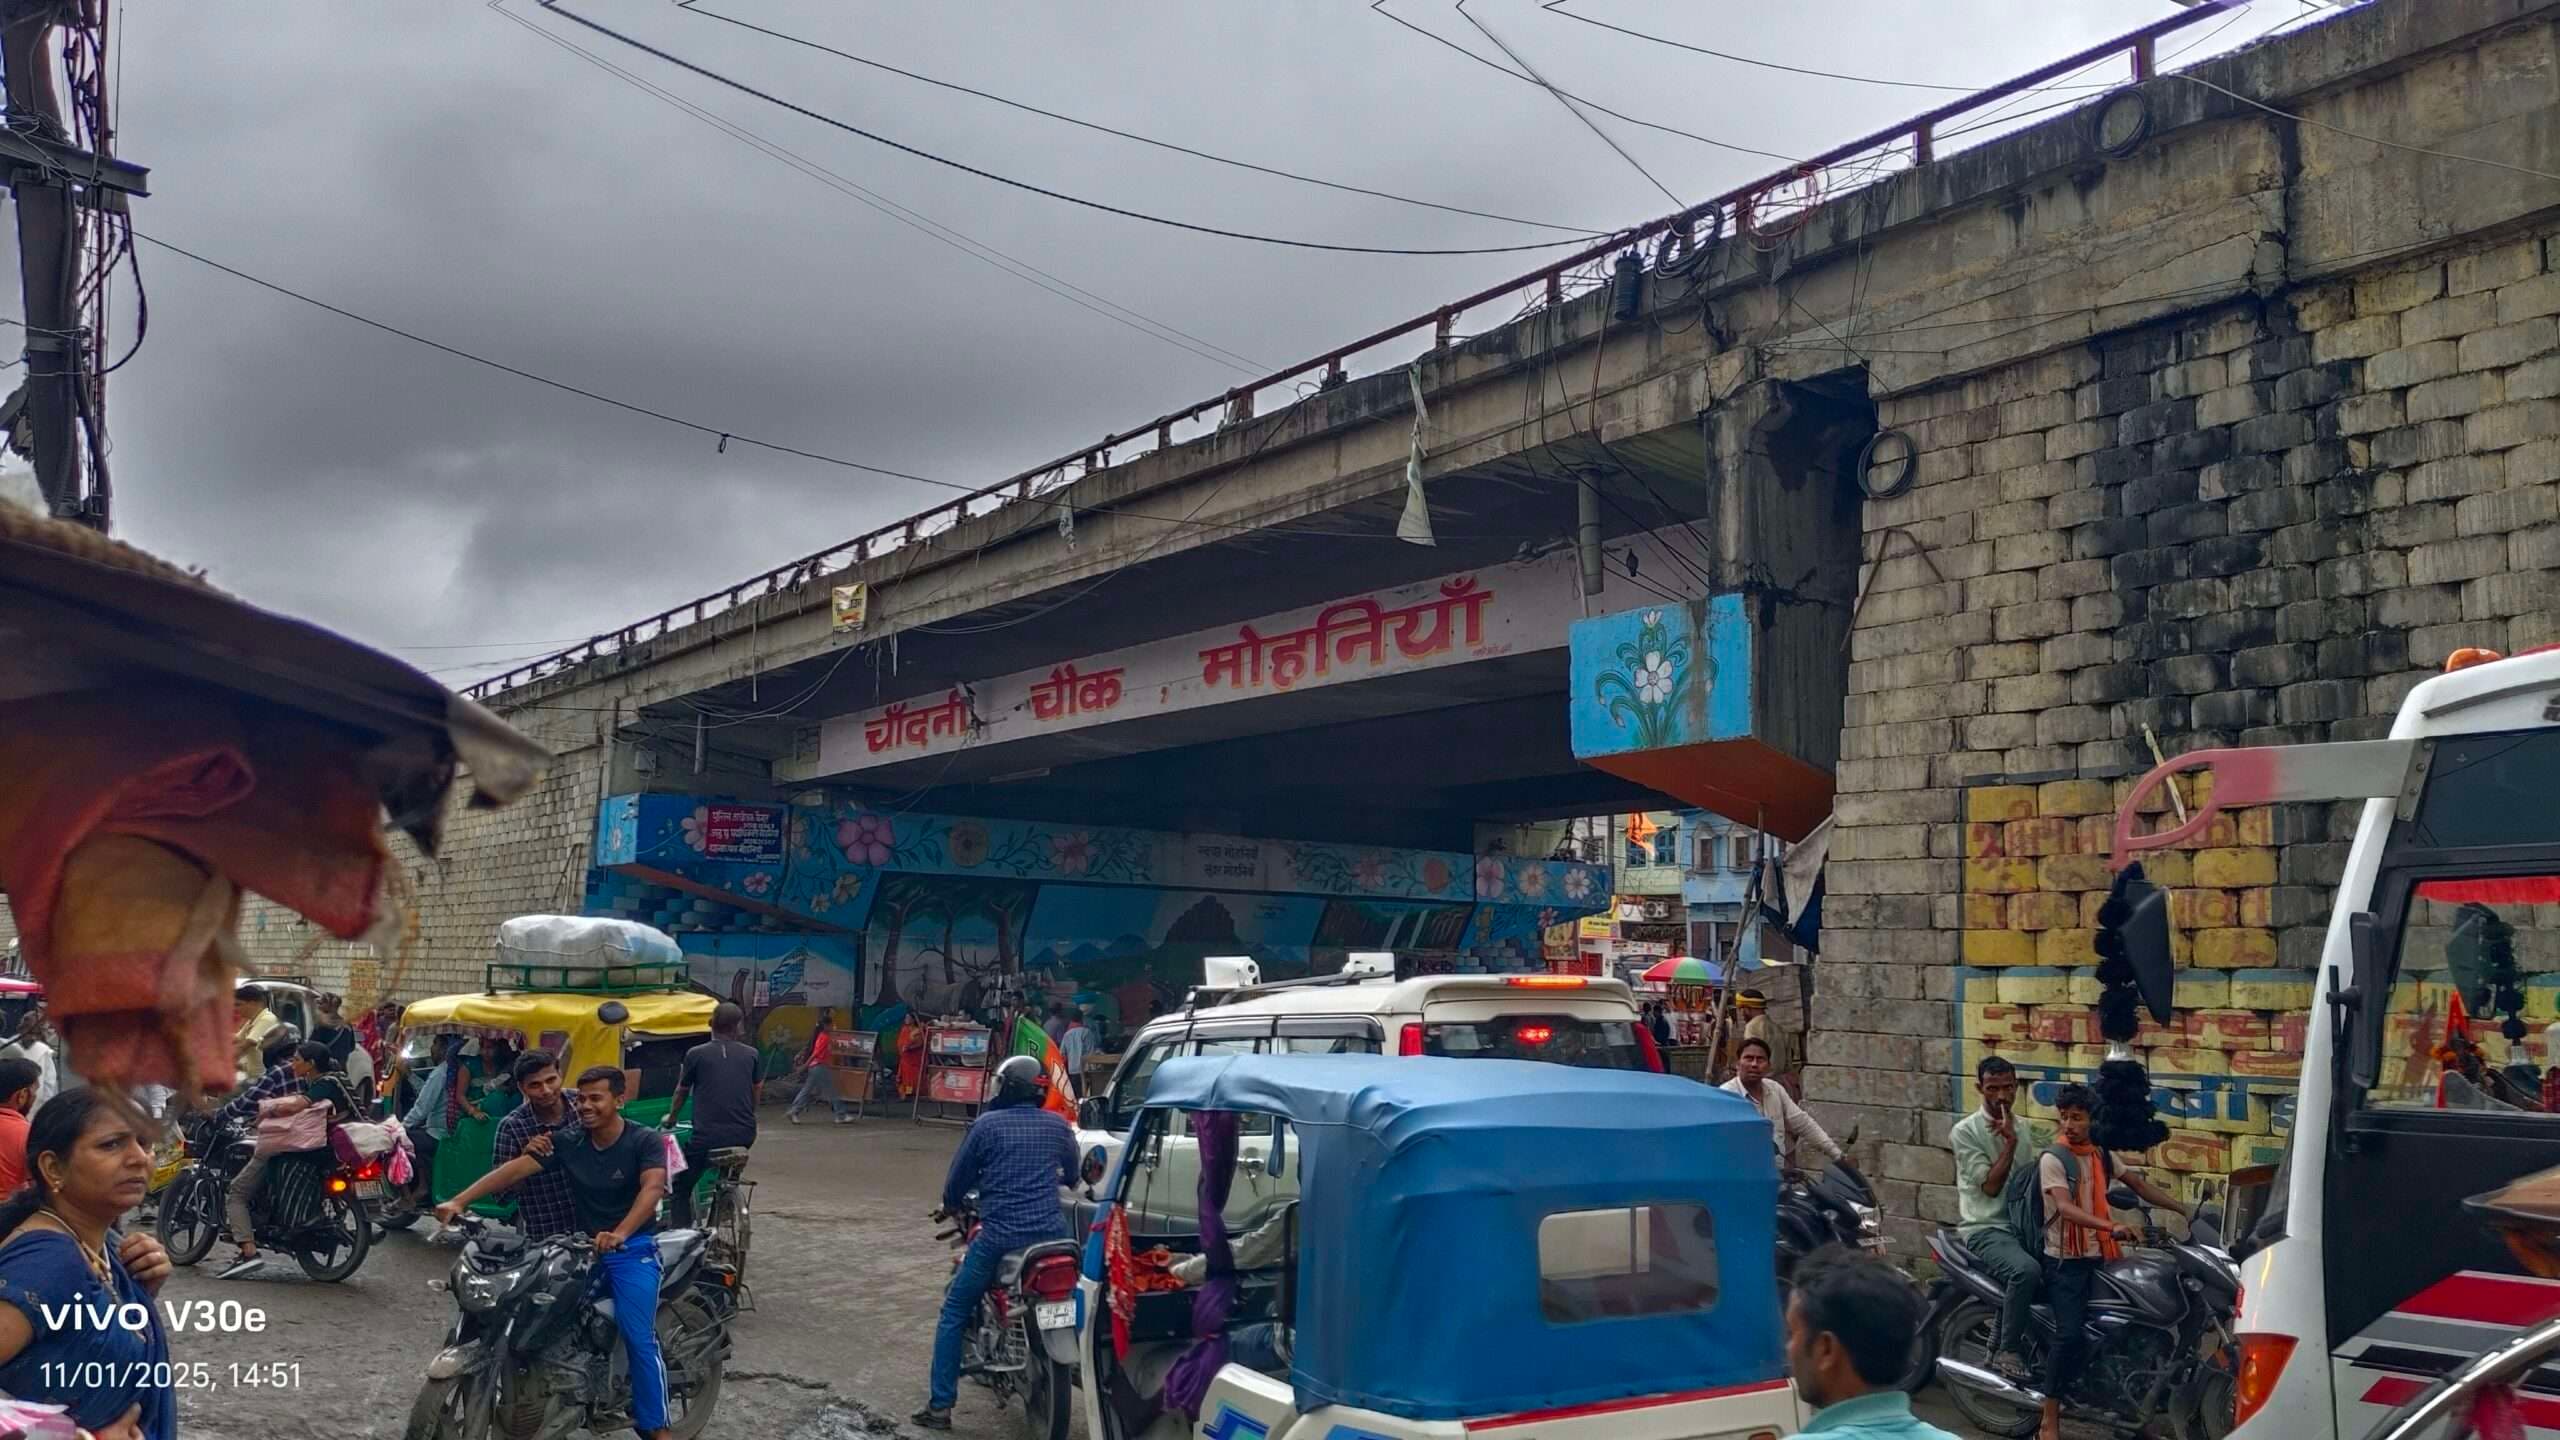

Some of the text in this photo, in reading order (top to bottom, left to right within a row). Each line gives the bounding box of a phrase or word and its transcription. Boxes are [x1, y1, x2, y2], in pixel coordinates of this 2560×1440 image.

[864, 688, 968, 753] चाँदनी
[1030, 663, 1126, 721] चौक
[1198, 575, 1496, 690] मोहनियाँ
